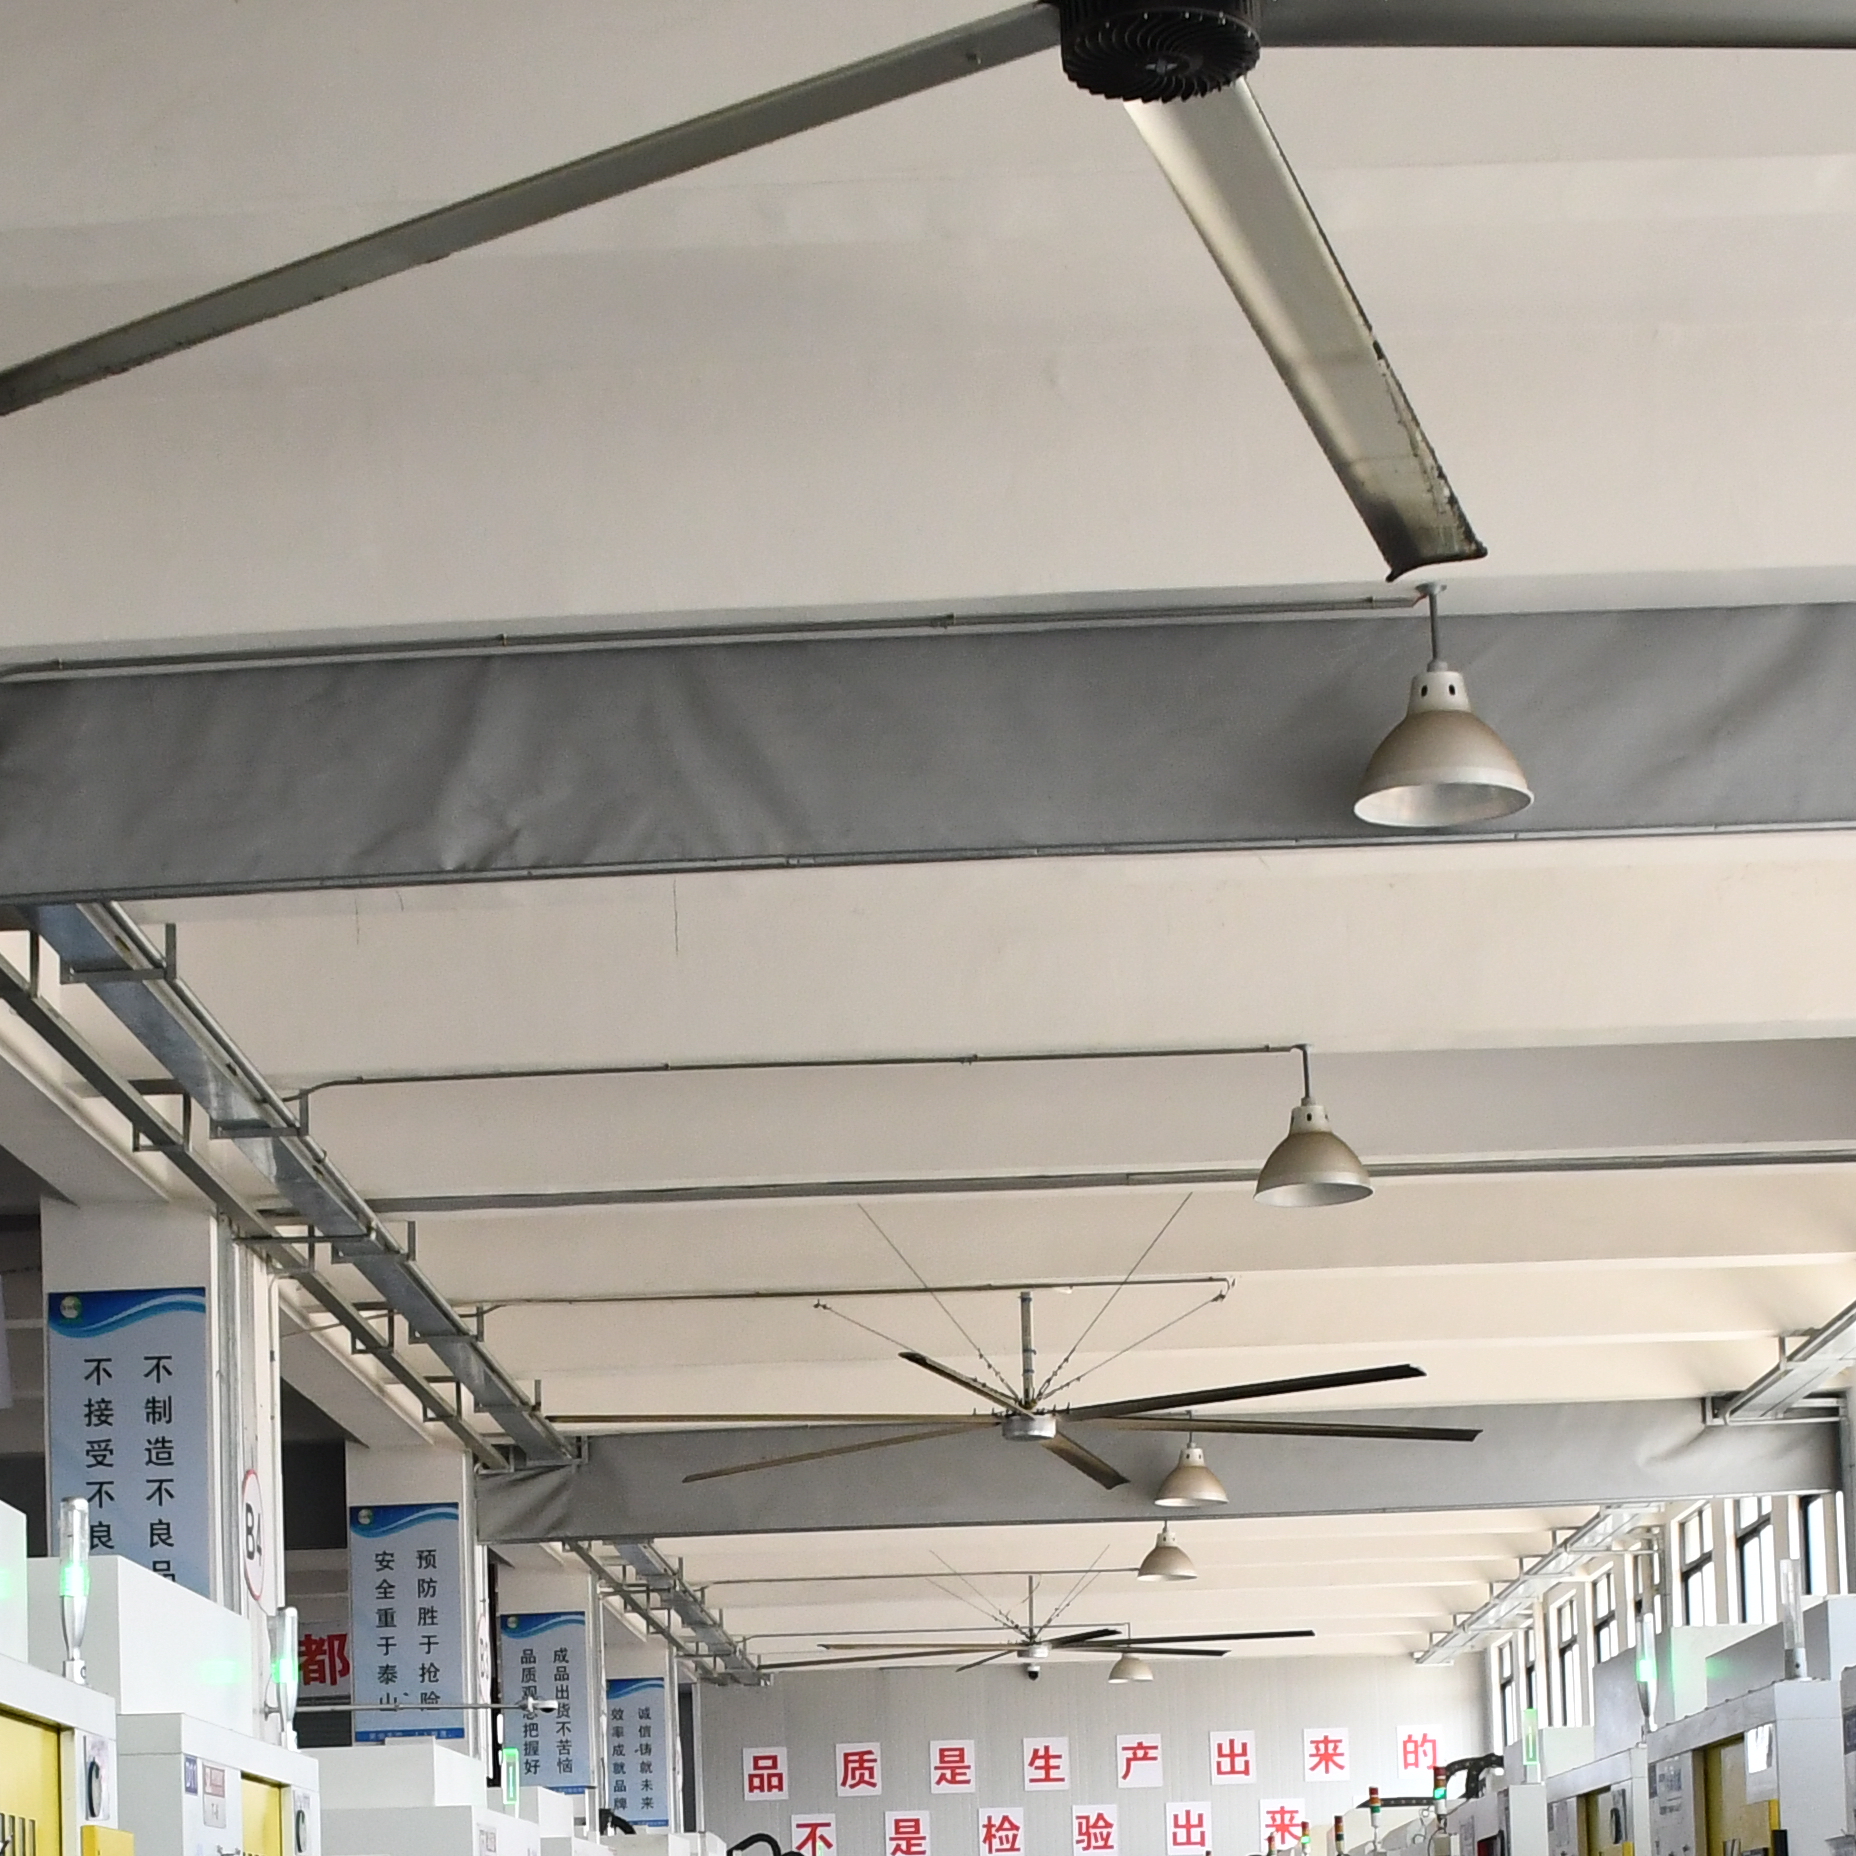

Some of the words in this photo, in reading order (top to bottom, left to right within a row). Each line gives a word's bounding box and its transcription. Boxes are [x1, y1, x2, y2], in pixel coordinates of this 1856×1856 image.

[374, 1550, 398, 1712] 安全重于泰山
[747, 1732, 1438, 1794] 品质是生产出来的
